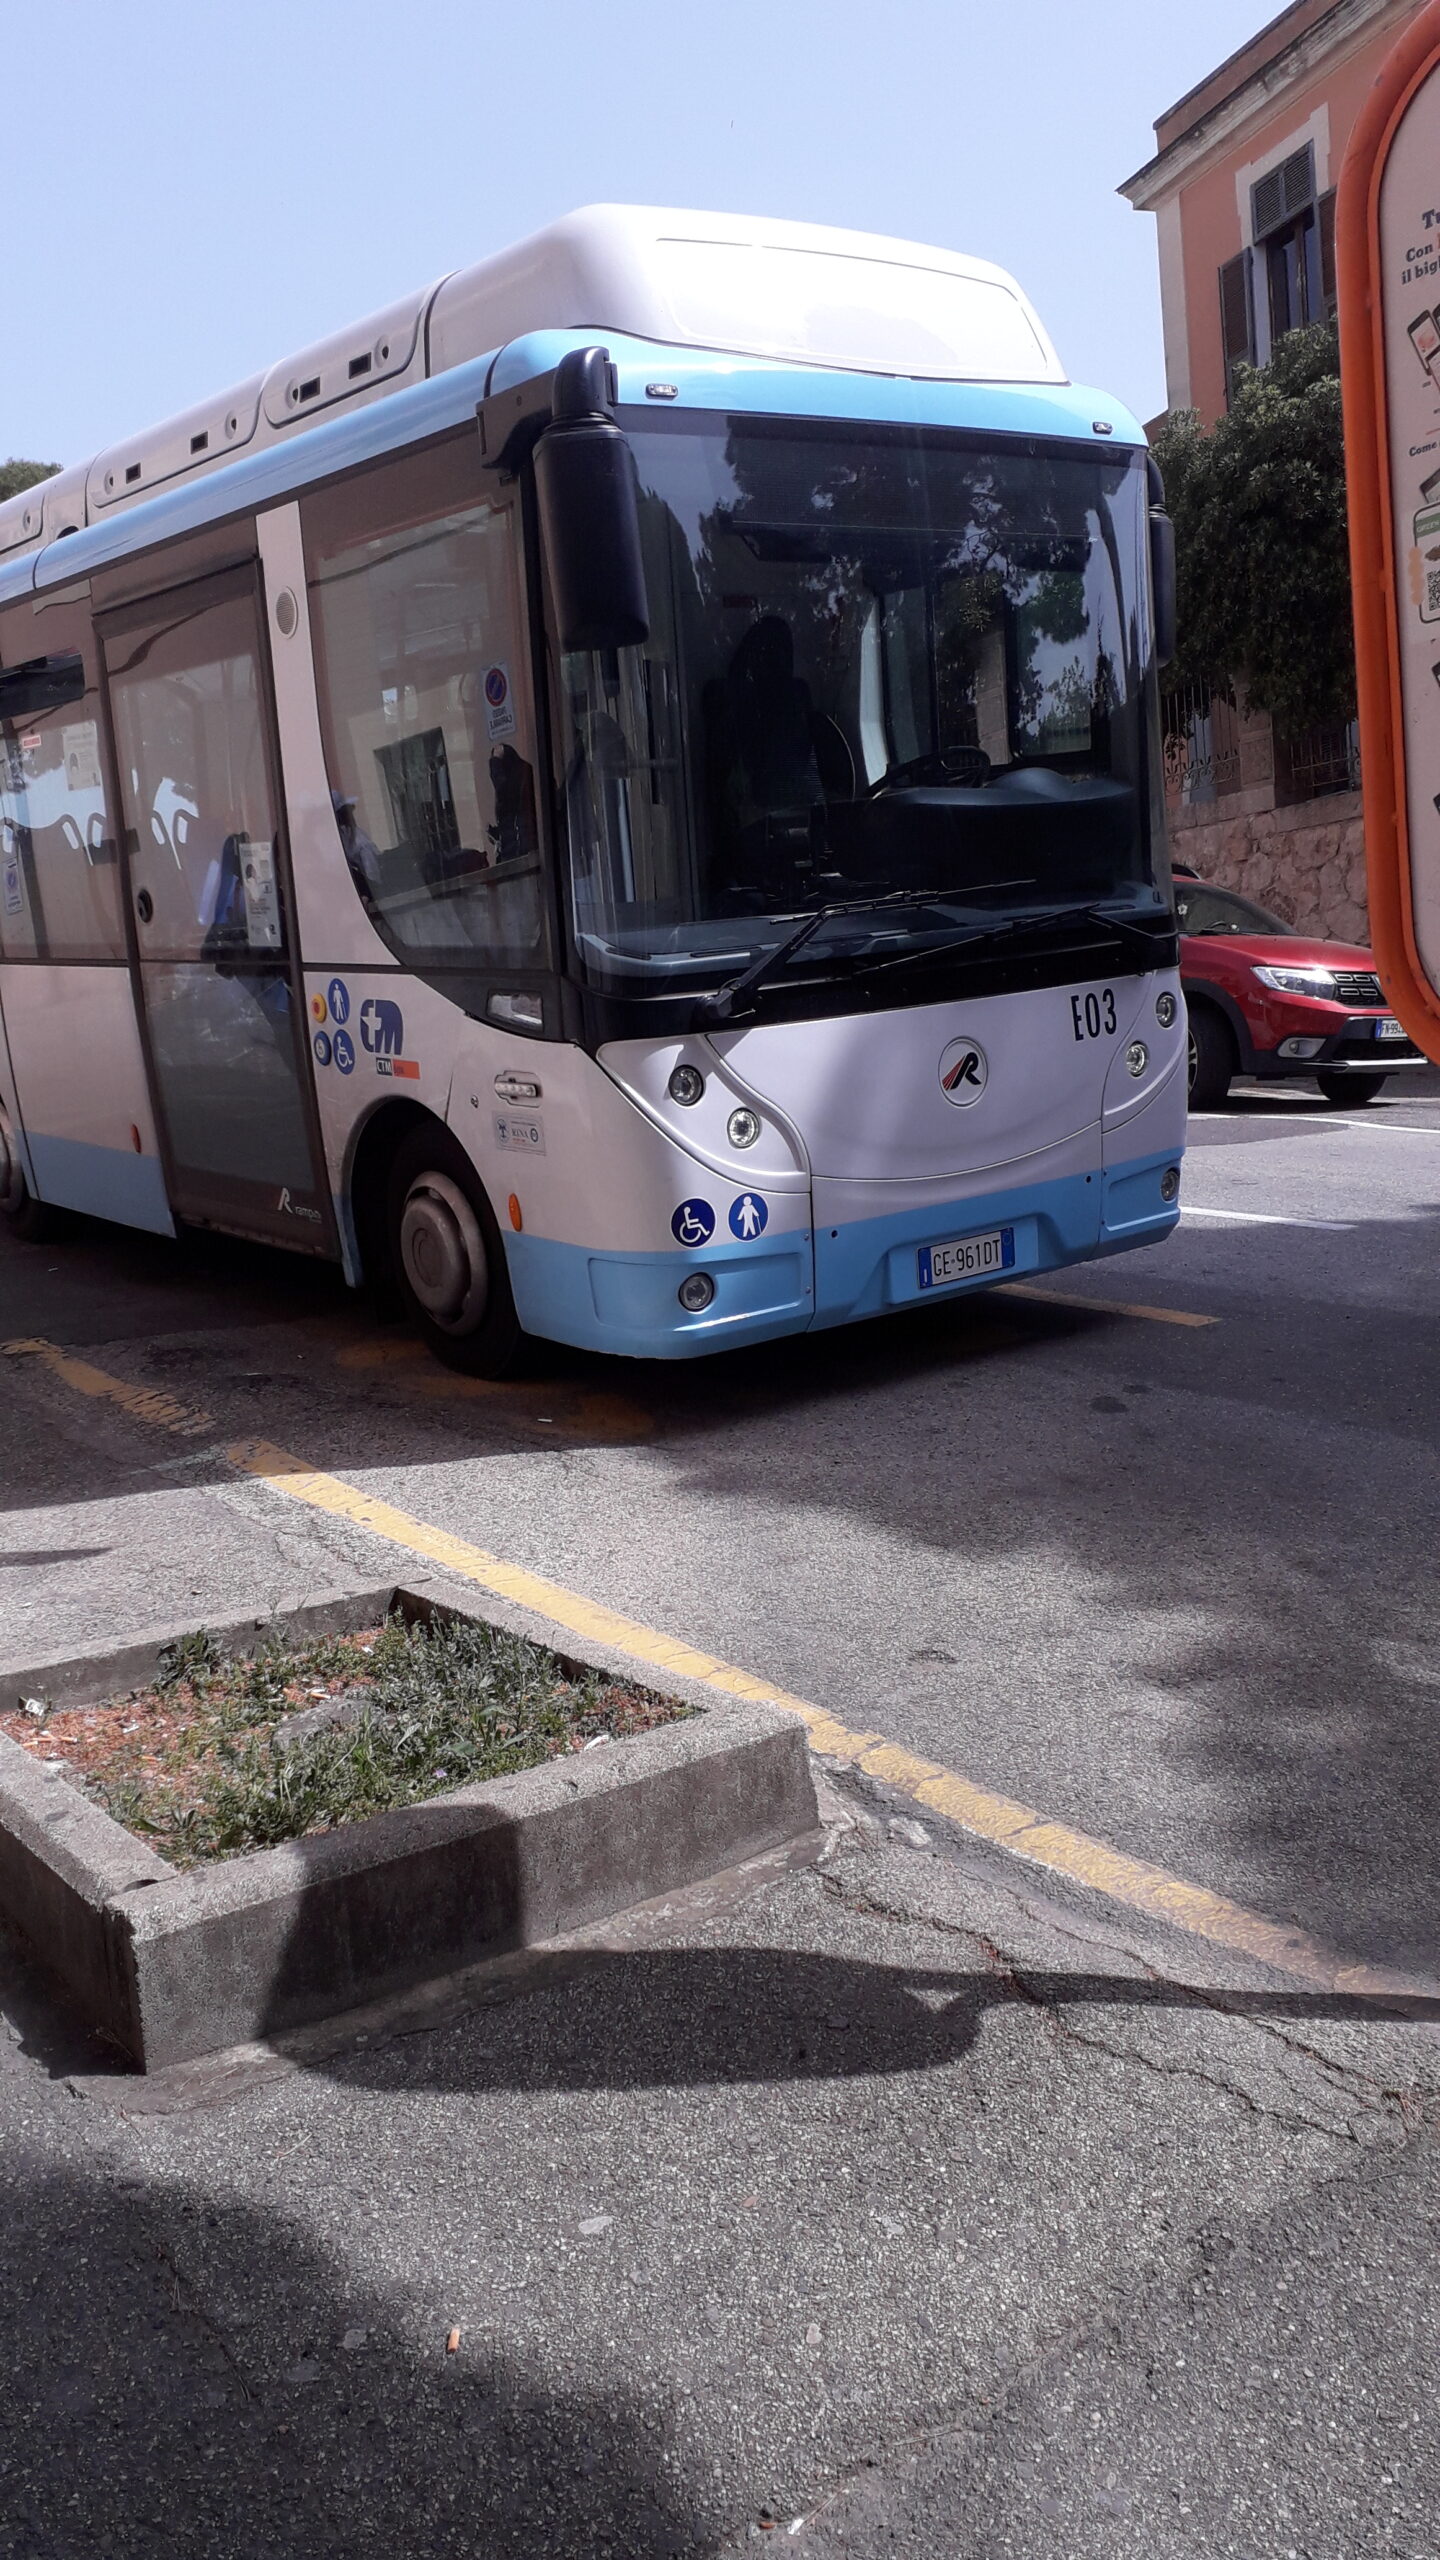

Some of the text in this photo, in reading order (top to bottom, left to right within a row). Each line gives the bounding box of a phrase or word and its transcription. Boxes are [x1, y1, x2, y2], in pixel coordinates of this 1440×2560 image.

[1406, 244, 1433, 262] Con
[1401, 256, 1440, 285] il big
[1409, 441, 1437, 457] Come
[1070, 987, 1117, 1041] E03
[376, 1059, 392, 1073] CTM
